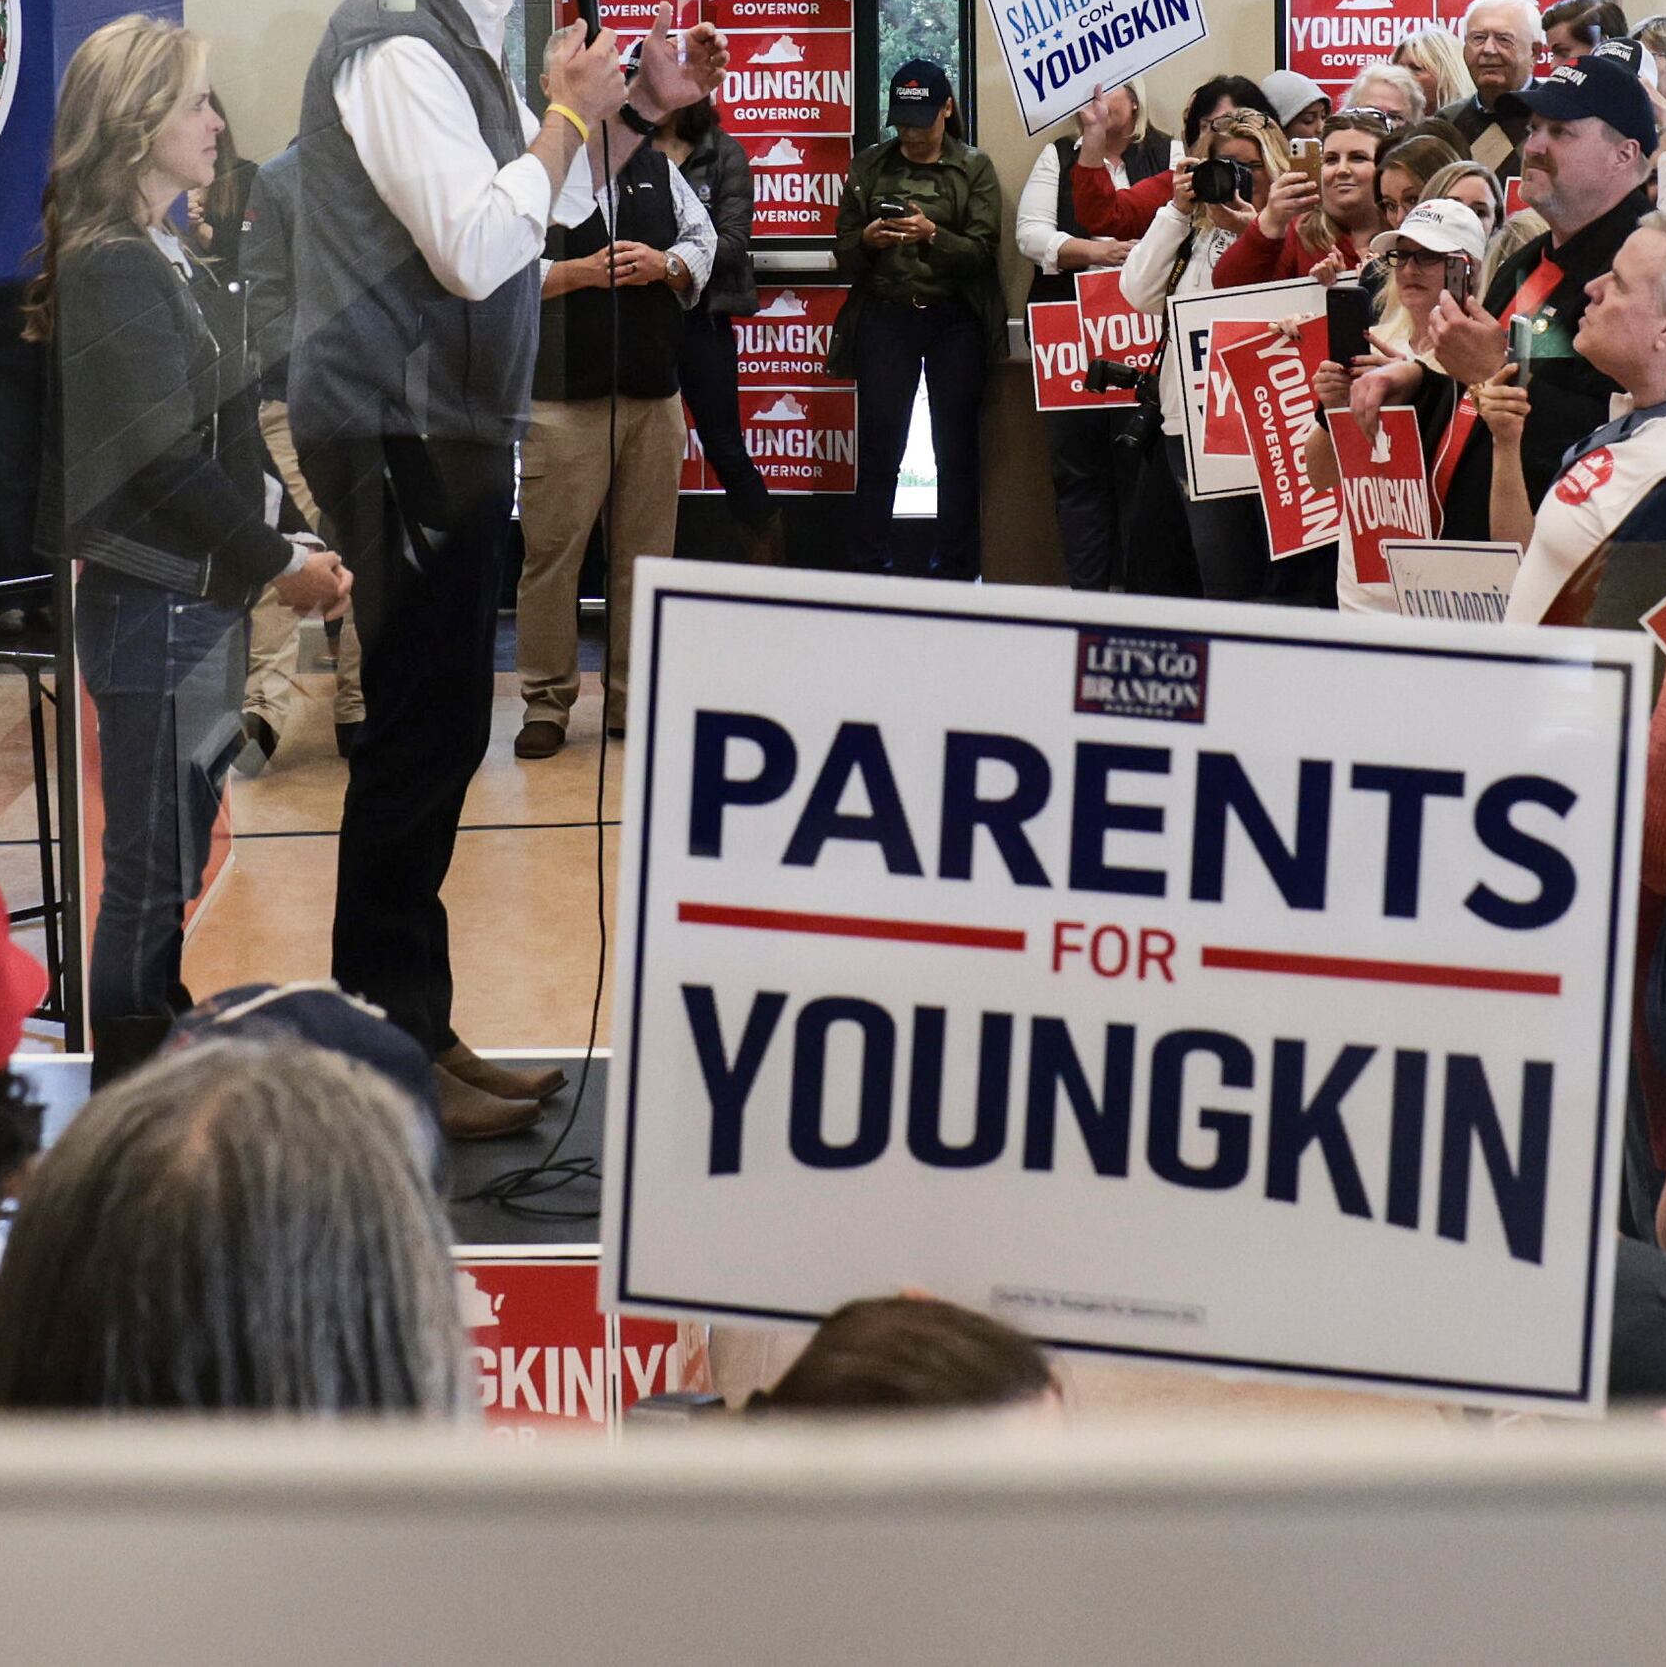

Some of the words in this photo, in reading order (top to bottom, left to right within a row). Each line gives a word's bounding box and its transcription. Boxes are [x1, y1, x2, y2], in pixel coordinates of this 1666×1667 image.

[733, 2, 820, 16] GOVERNOR
[1078, 0, 1114, 29] CON
[710, 70, 851, 108] OUNGKIN
[734, 106, 820, 121] GOVERNOR
[737, 361, 821, 374] GOVERNOR
[742, 428, 854, 465] UNGKIN
[1253, 386, 1294, 508] GOVERNOR
[1157, 651, 1198, 680] GO
[1080, 674, 1200, 710] BRANDON
[685, 707, 1580, 931] PARENTS
[1050, 919, 1178, 984] FOR
[679, 980, 1556, 1268] YOUNGKIN
